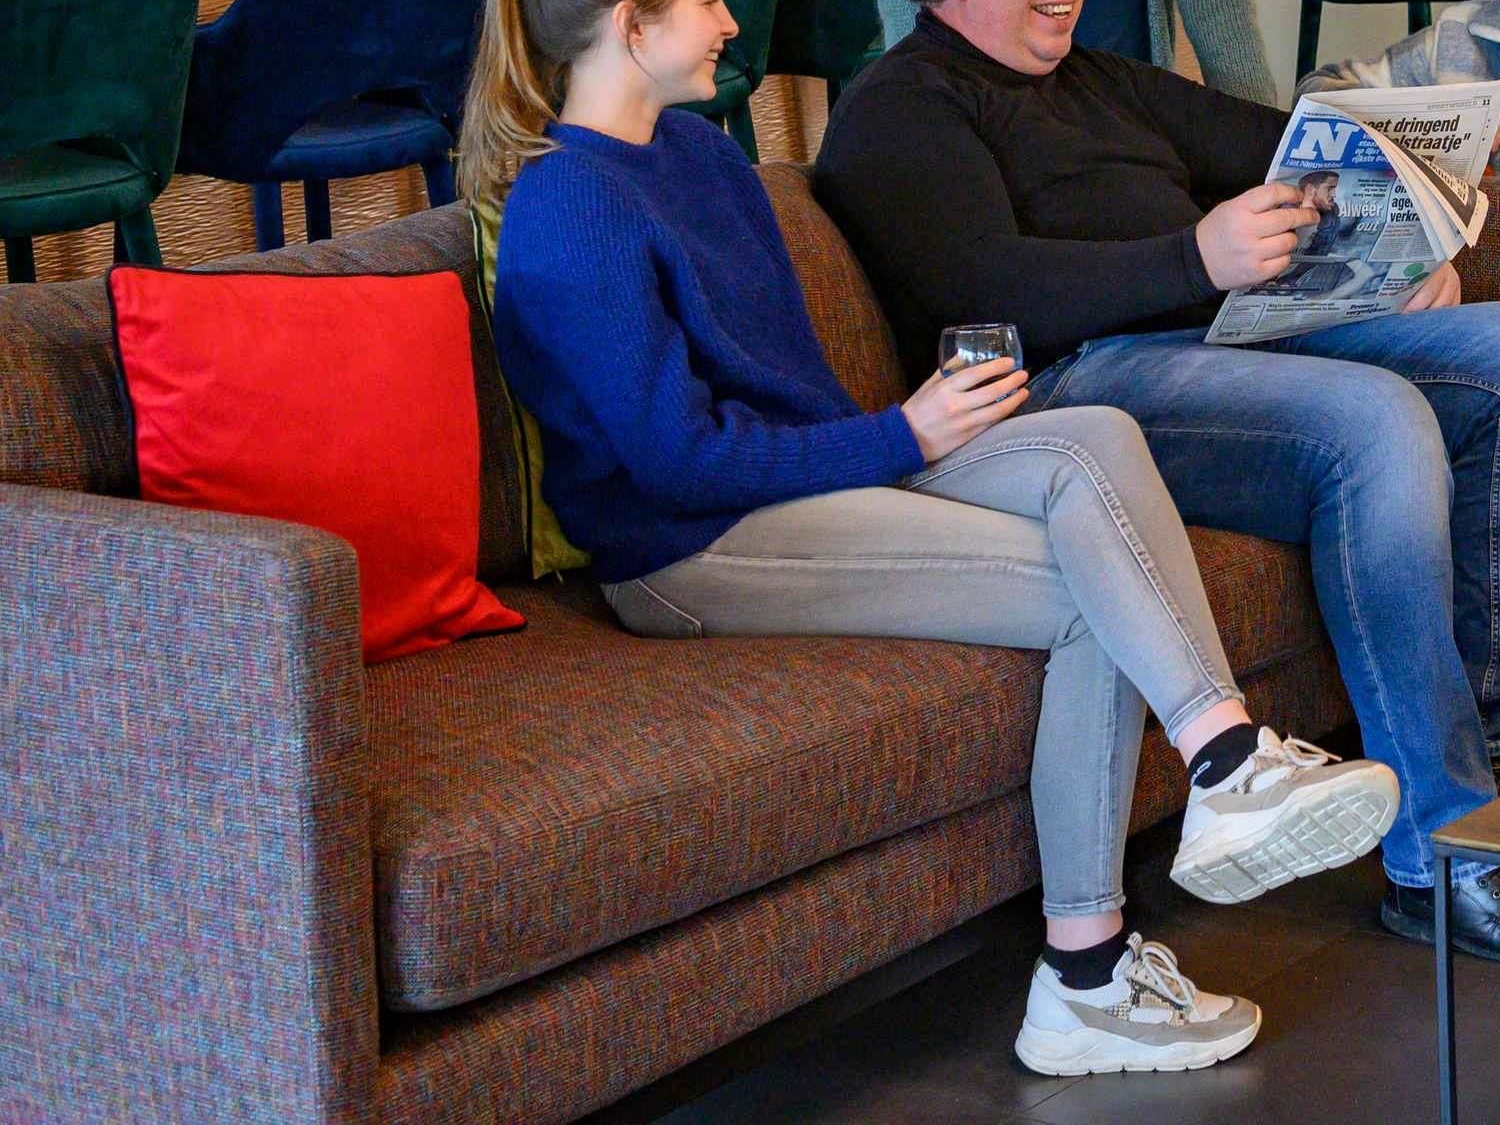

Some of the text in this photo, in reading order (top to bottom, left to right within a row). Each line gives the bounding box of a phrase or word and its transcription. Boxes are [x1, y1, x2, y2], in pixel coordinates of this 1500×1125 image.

[1362, 114, 1461, 136] oet dringend
[1290, 121, 1361, 161] N
